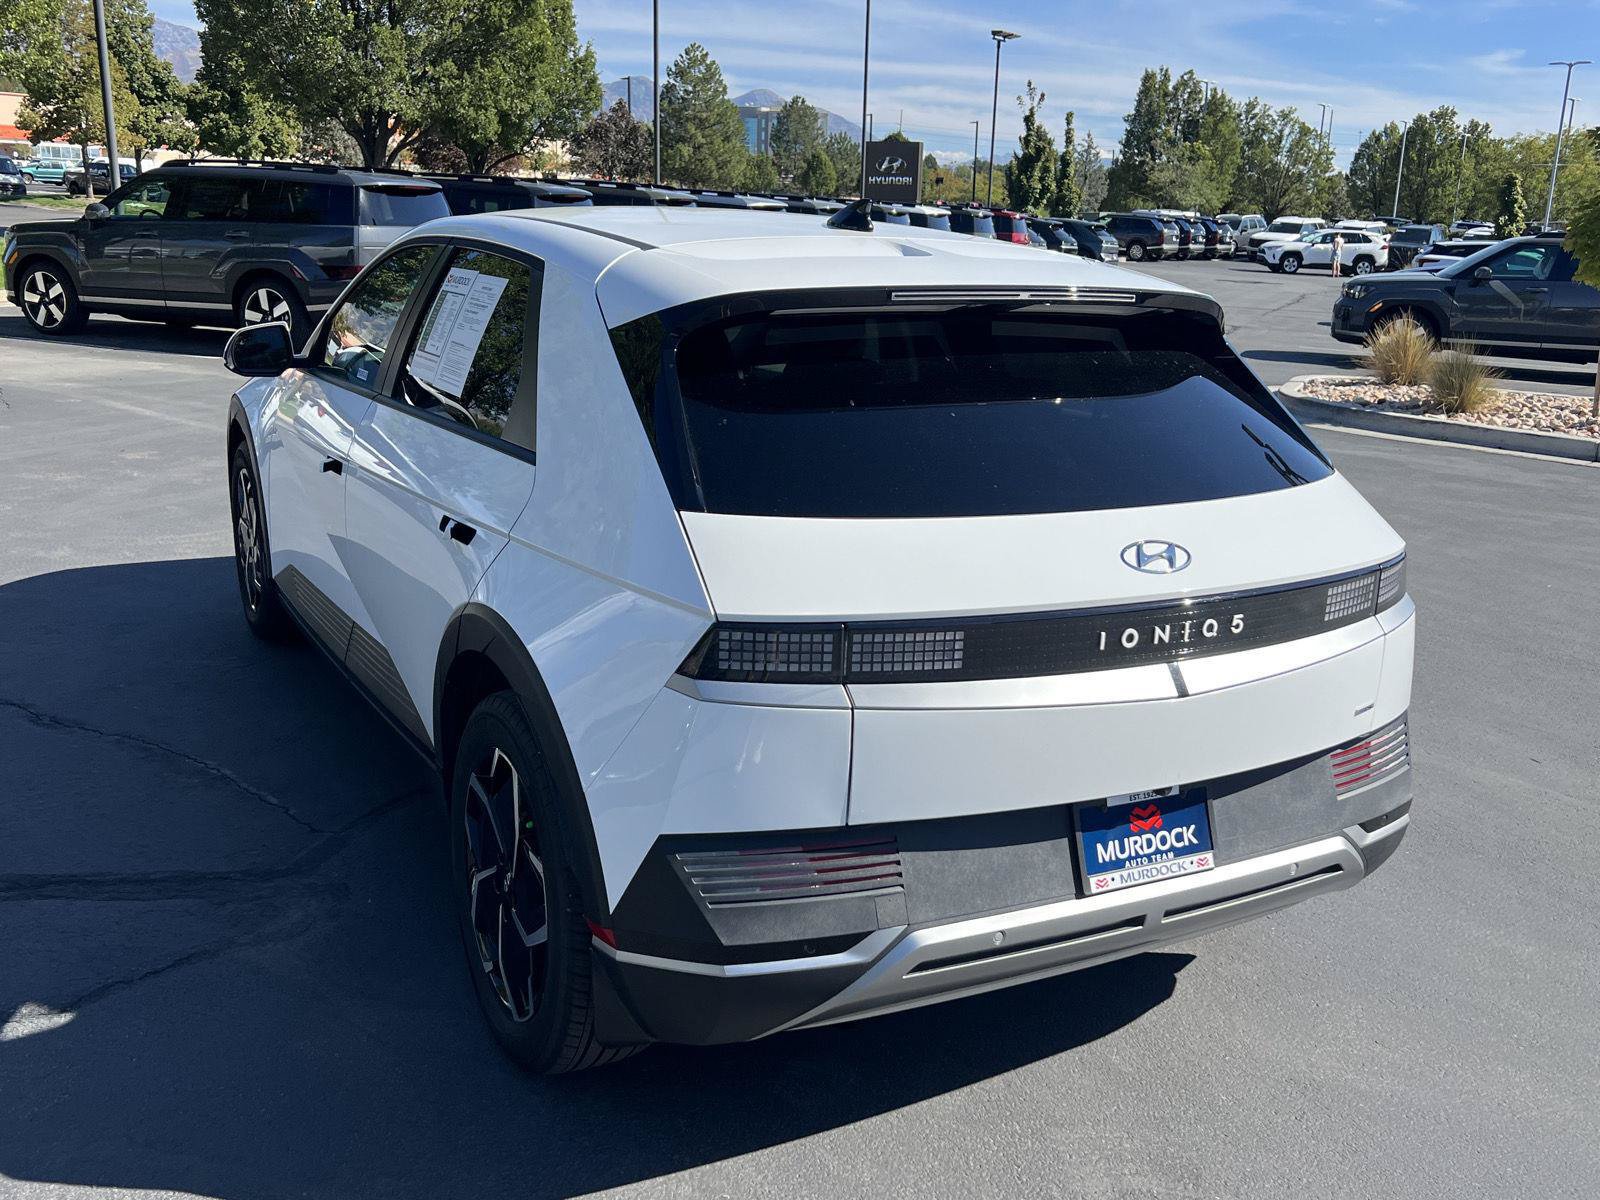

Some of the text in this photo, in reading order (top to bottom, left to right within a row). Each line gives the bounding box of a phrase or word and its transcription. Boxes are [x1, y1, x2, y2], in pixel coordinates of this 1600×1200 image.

[868, 176, 913, 185] HYUNDAI
[1099, 613, 1245, 650] IONIQ 5
[1096, 824, 1199, 863] MURDOCK
[1120, 860, 1188, 884] MURDOCK
[1125, 852, 1174, 868] AUTO TEAM
